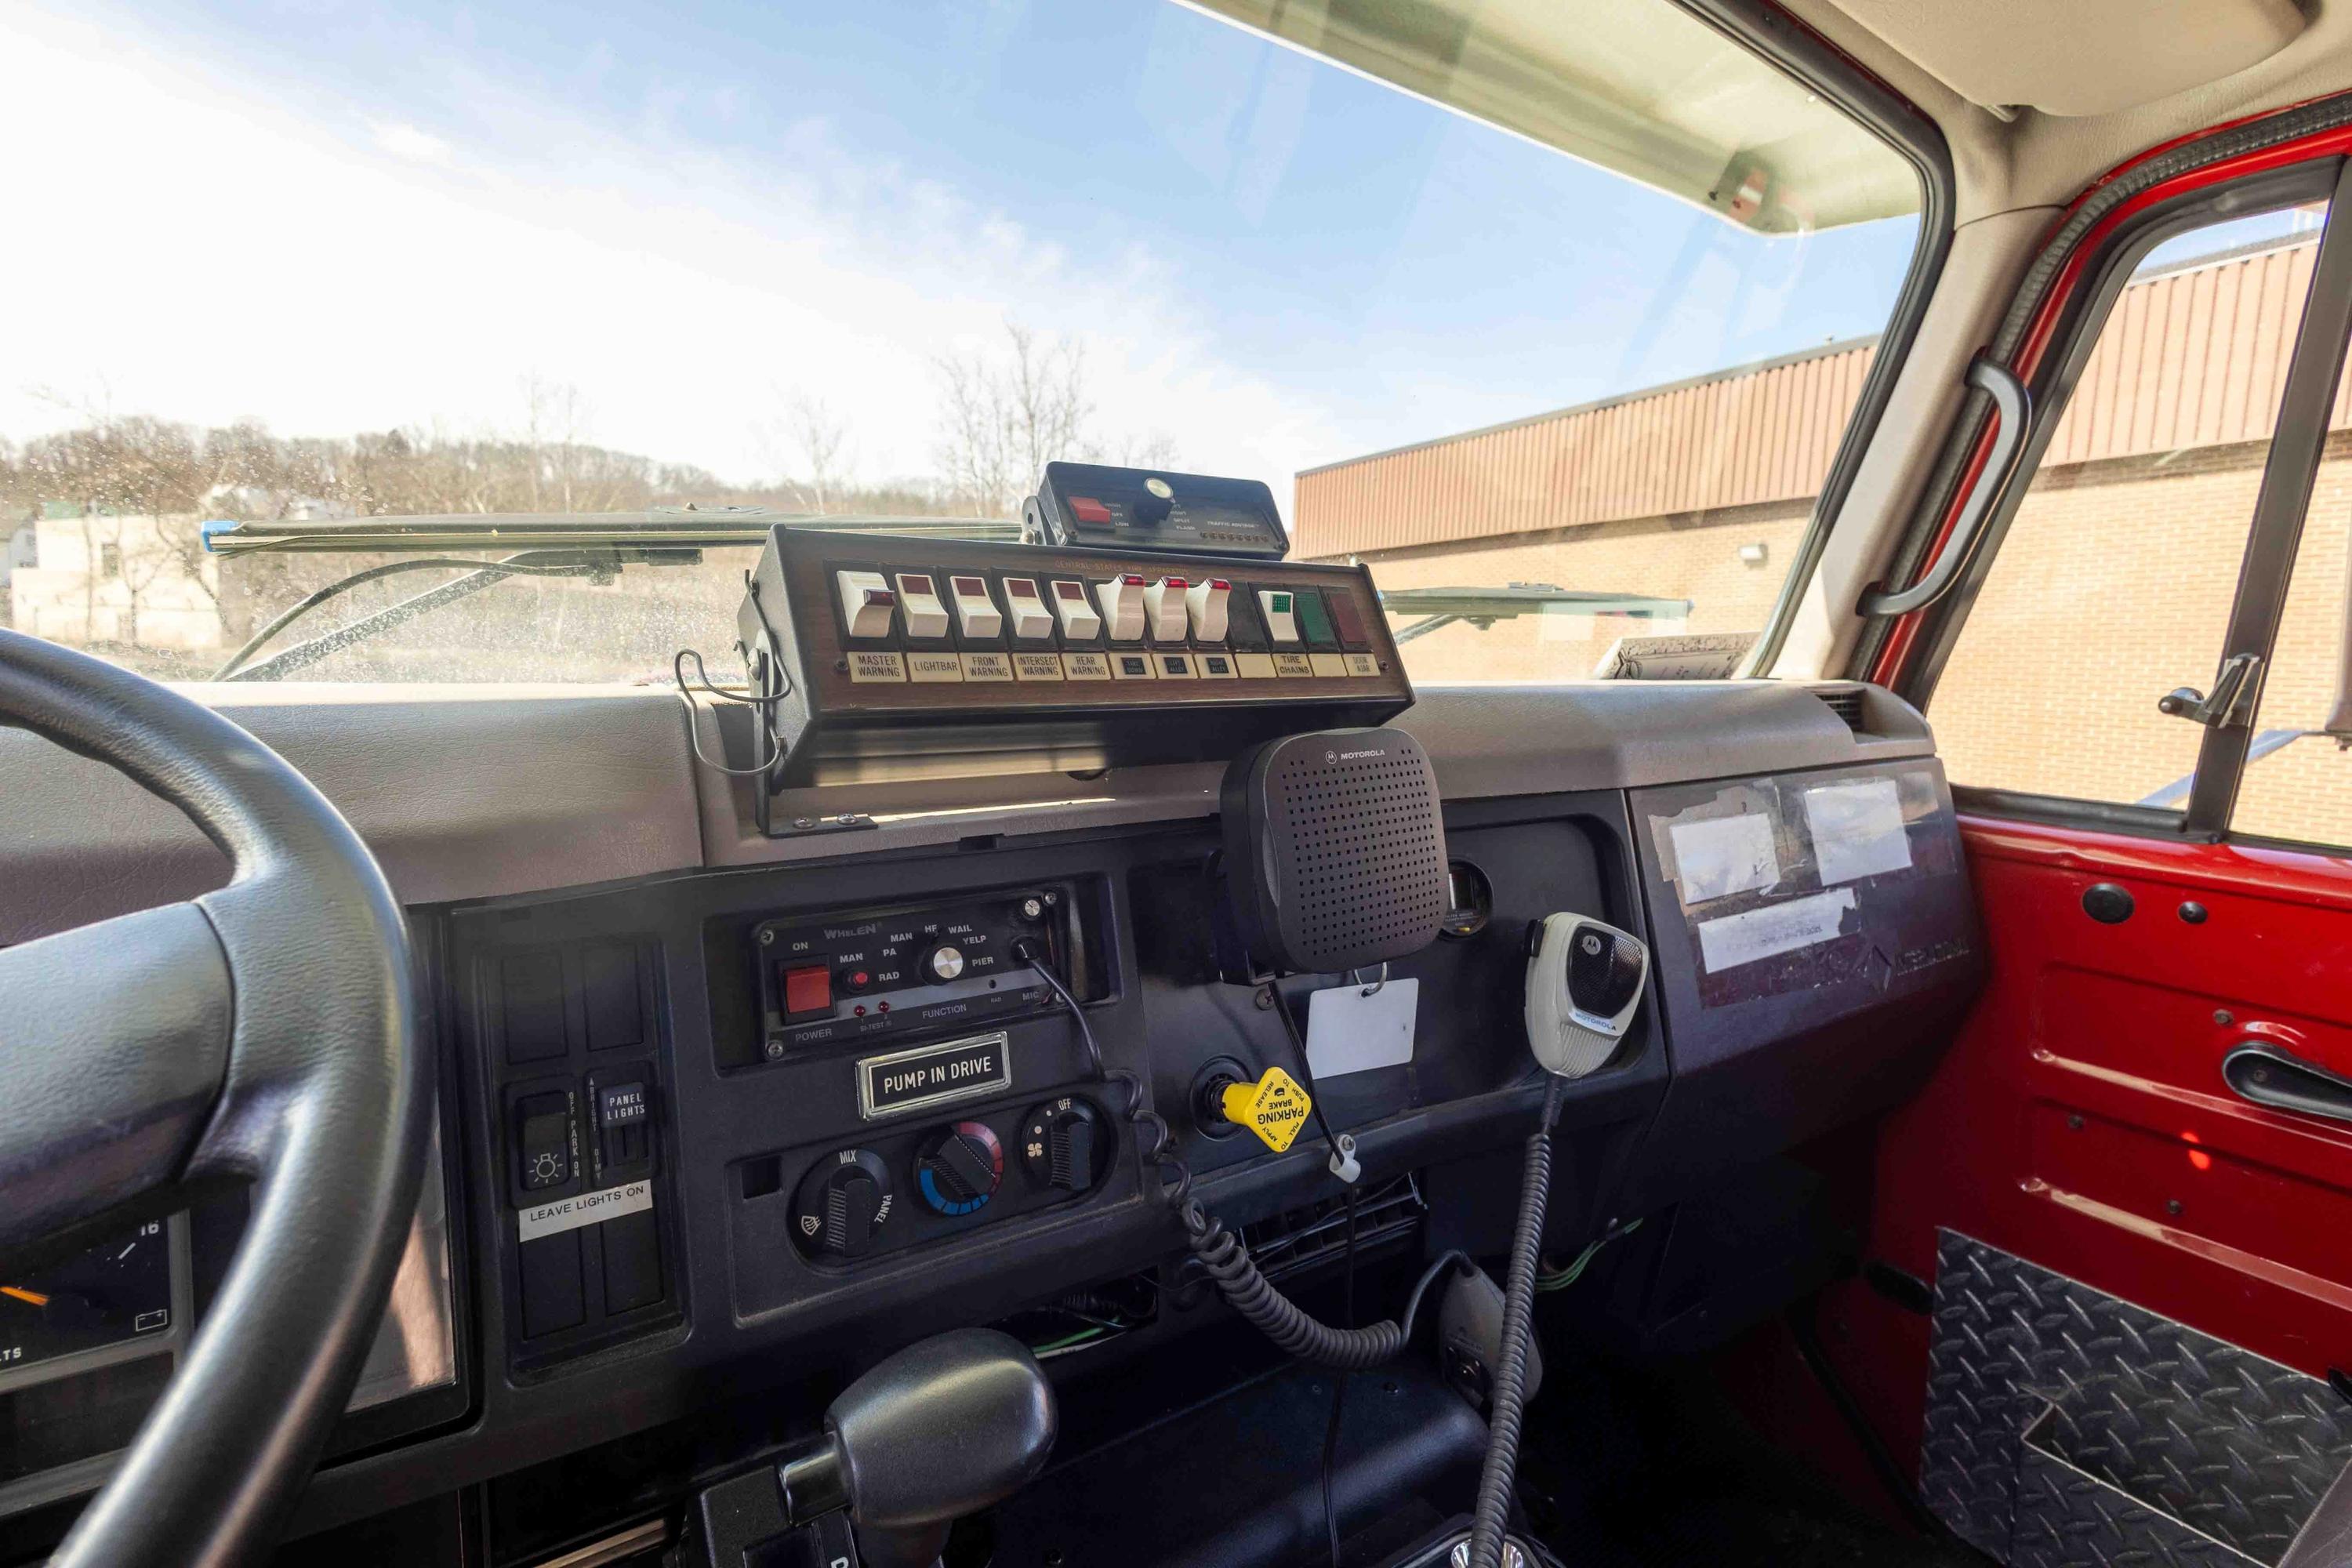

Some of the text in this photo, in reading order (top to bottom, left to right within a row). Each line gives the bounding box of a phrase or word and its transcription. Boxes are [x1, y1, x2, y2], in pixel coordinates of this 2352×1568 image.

[858, 655, 897, 666] MASTER
[972, 656, 1000, 666] FRONT
[1018, 656, 1058, 666] INTERSECT
[1076, 656, 1095, 666] REAR
[858, 666, 900, 677] WARNING
[913, 661, 958, 672] LIGHTBAR
[969, 666, 1008, 677] WARNING
[1022, 666, 1059, 676] WARNING
[1071, 666, 1106, 676] WARNING
[1279, 666, 1310, 674] CHAINS
[1341, 750, 1385, 760] MOTOROLA
[925, 924, 937, 934] HF
[948, 924, 972, 935] WAIL
[890, 932, 913, 943] MAN
[963, 935, 986, 945] YELP
[793, 942, 808, 950] ON
[883, 948, 897, 957] PA
[839, 953, 863, 964] MAN
[972, 956, 994, 967] PIER
[878, 971, 900, 982] RAD
[1022, 992, 1040, 1000] MIC
[922, 1004, 967, 1018] FUNCTION
[1575, 1013, 1617, 1031] MOTOROLA
[795, 1028, 833, 1042] POWER
[884, 1056, 992, 1094] PUMP IN DRIVE
[1255, 1078, 1305, 1109] PUSH TO RELEASE
[609, 1092, 641, 1107] PANEL
[1058, 1098, 1072, 1111] OFF
[1269, 1098, 1293, 1109] BRAKE
[607, 1104, 645, 1120] LIGHTS
[1258, 1106, 1304, 1124] PARKING
[1262, 1122, 1300, 1150] PULL TO APPLY
[839, 1149, 857, 1164] MIX
[574, 1161, 579, 1178] ON
[530, 1185, 644, 1221] LEAVE LIGHTS ON
[874, 1194, 892, 1224] PANEL
[140, 1221, 160, 1236] 16
[0, 1347, 21, 1361] TS
